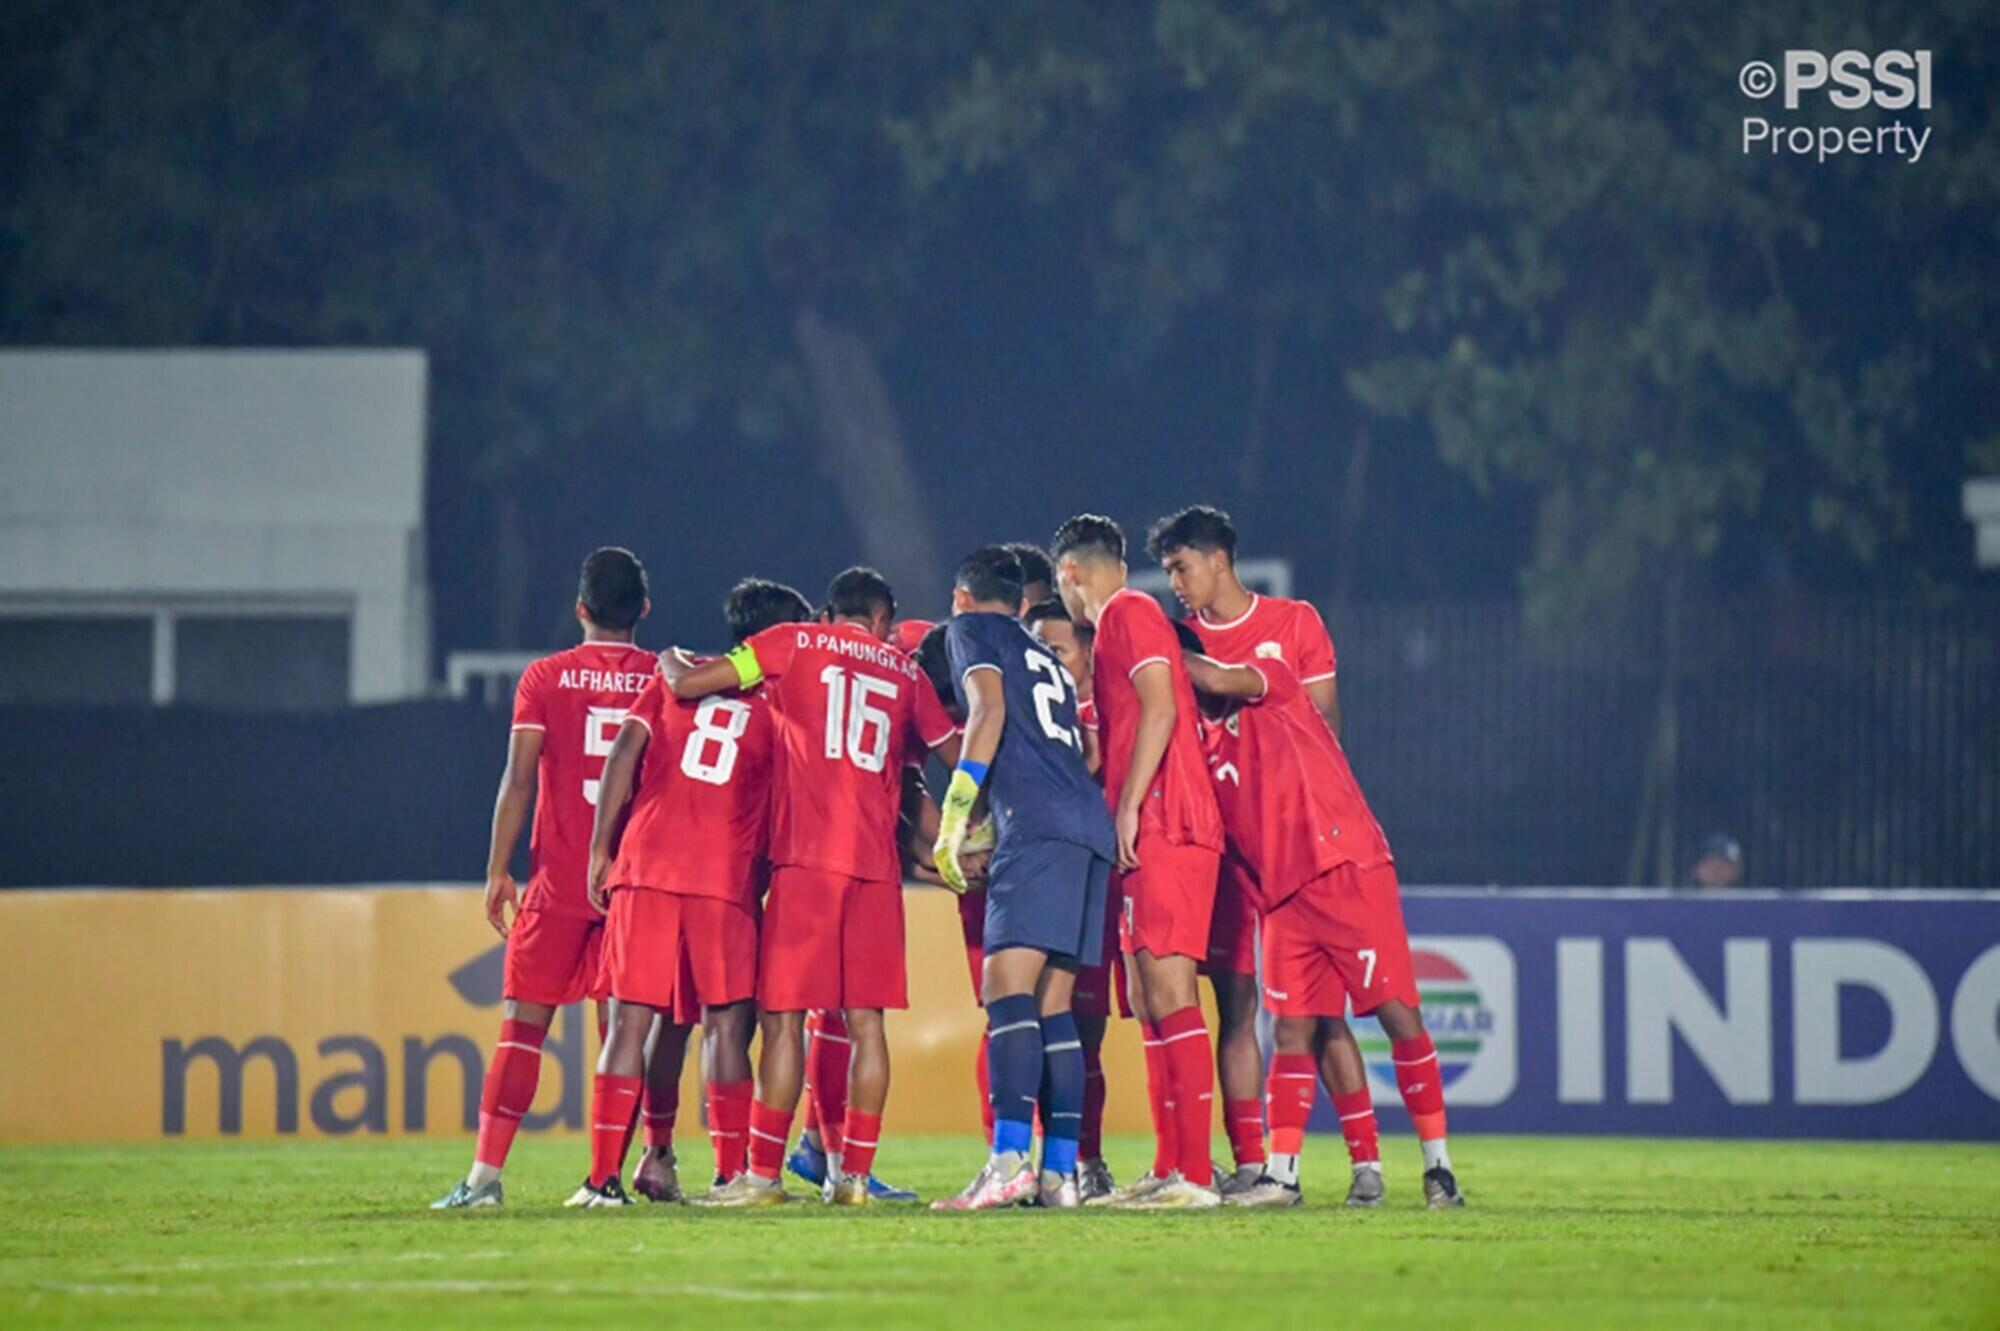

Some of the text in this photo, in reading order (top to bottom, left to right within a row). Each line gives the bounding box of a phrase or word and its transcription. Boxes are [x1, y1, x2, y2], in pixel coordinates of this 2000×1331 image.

[797, 631, 918, 681] D. PAMUNGKAS
[583, 705, 630, 806] 5
[680, 696, 752, 786] 8
[821, 664, 898, 773] 16
[1357, 949, 1376, 989] 7
[161, 1003, 586, 1136] mand
